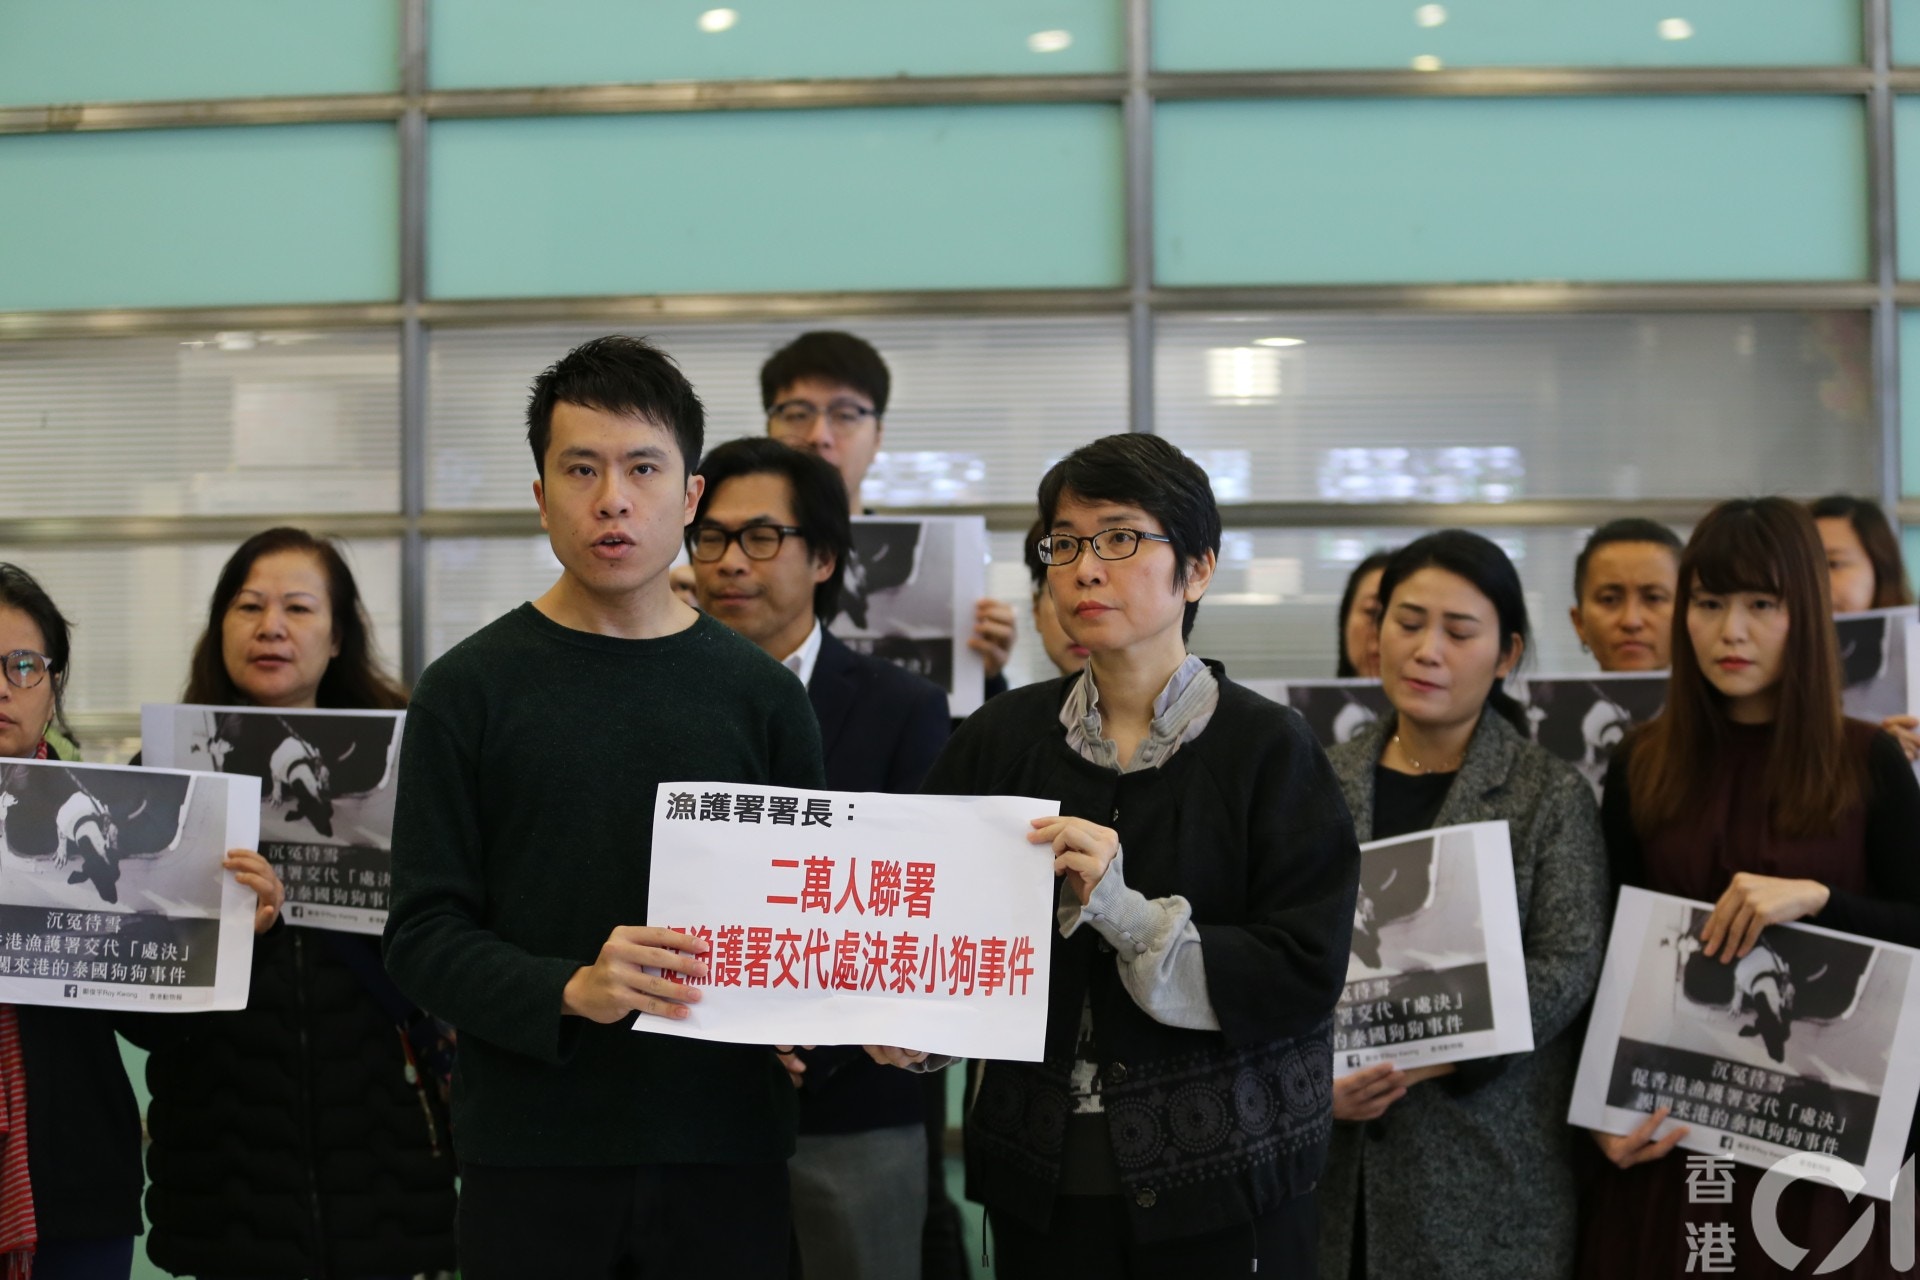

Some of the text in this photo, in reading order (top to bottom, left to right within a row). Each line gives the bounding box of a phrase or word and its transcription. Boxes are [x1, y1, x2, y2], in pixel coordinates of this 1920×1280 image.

[665, 791, 855, 828] 漁護署署長：
[766, 855, 936, 918] 二萬人聯署
[46, 911, 122, 934] 沉冤待雪
[0, 932, 190, 962] 港漁護署交代「處決」
[1711, 1060, 1787, 1094] 沉冤待雪
